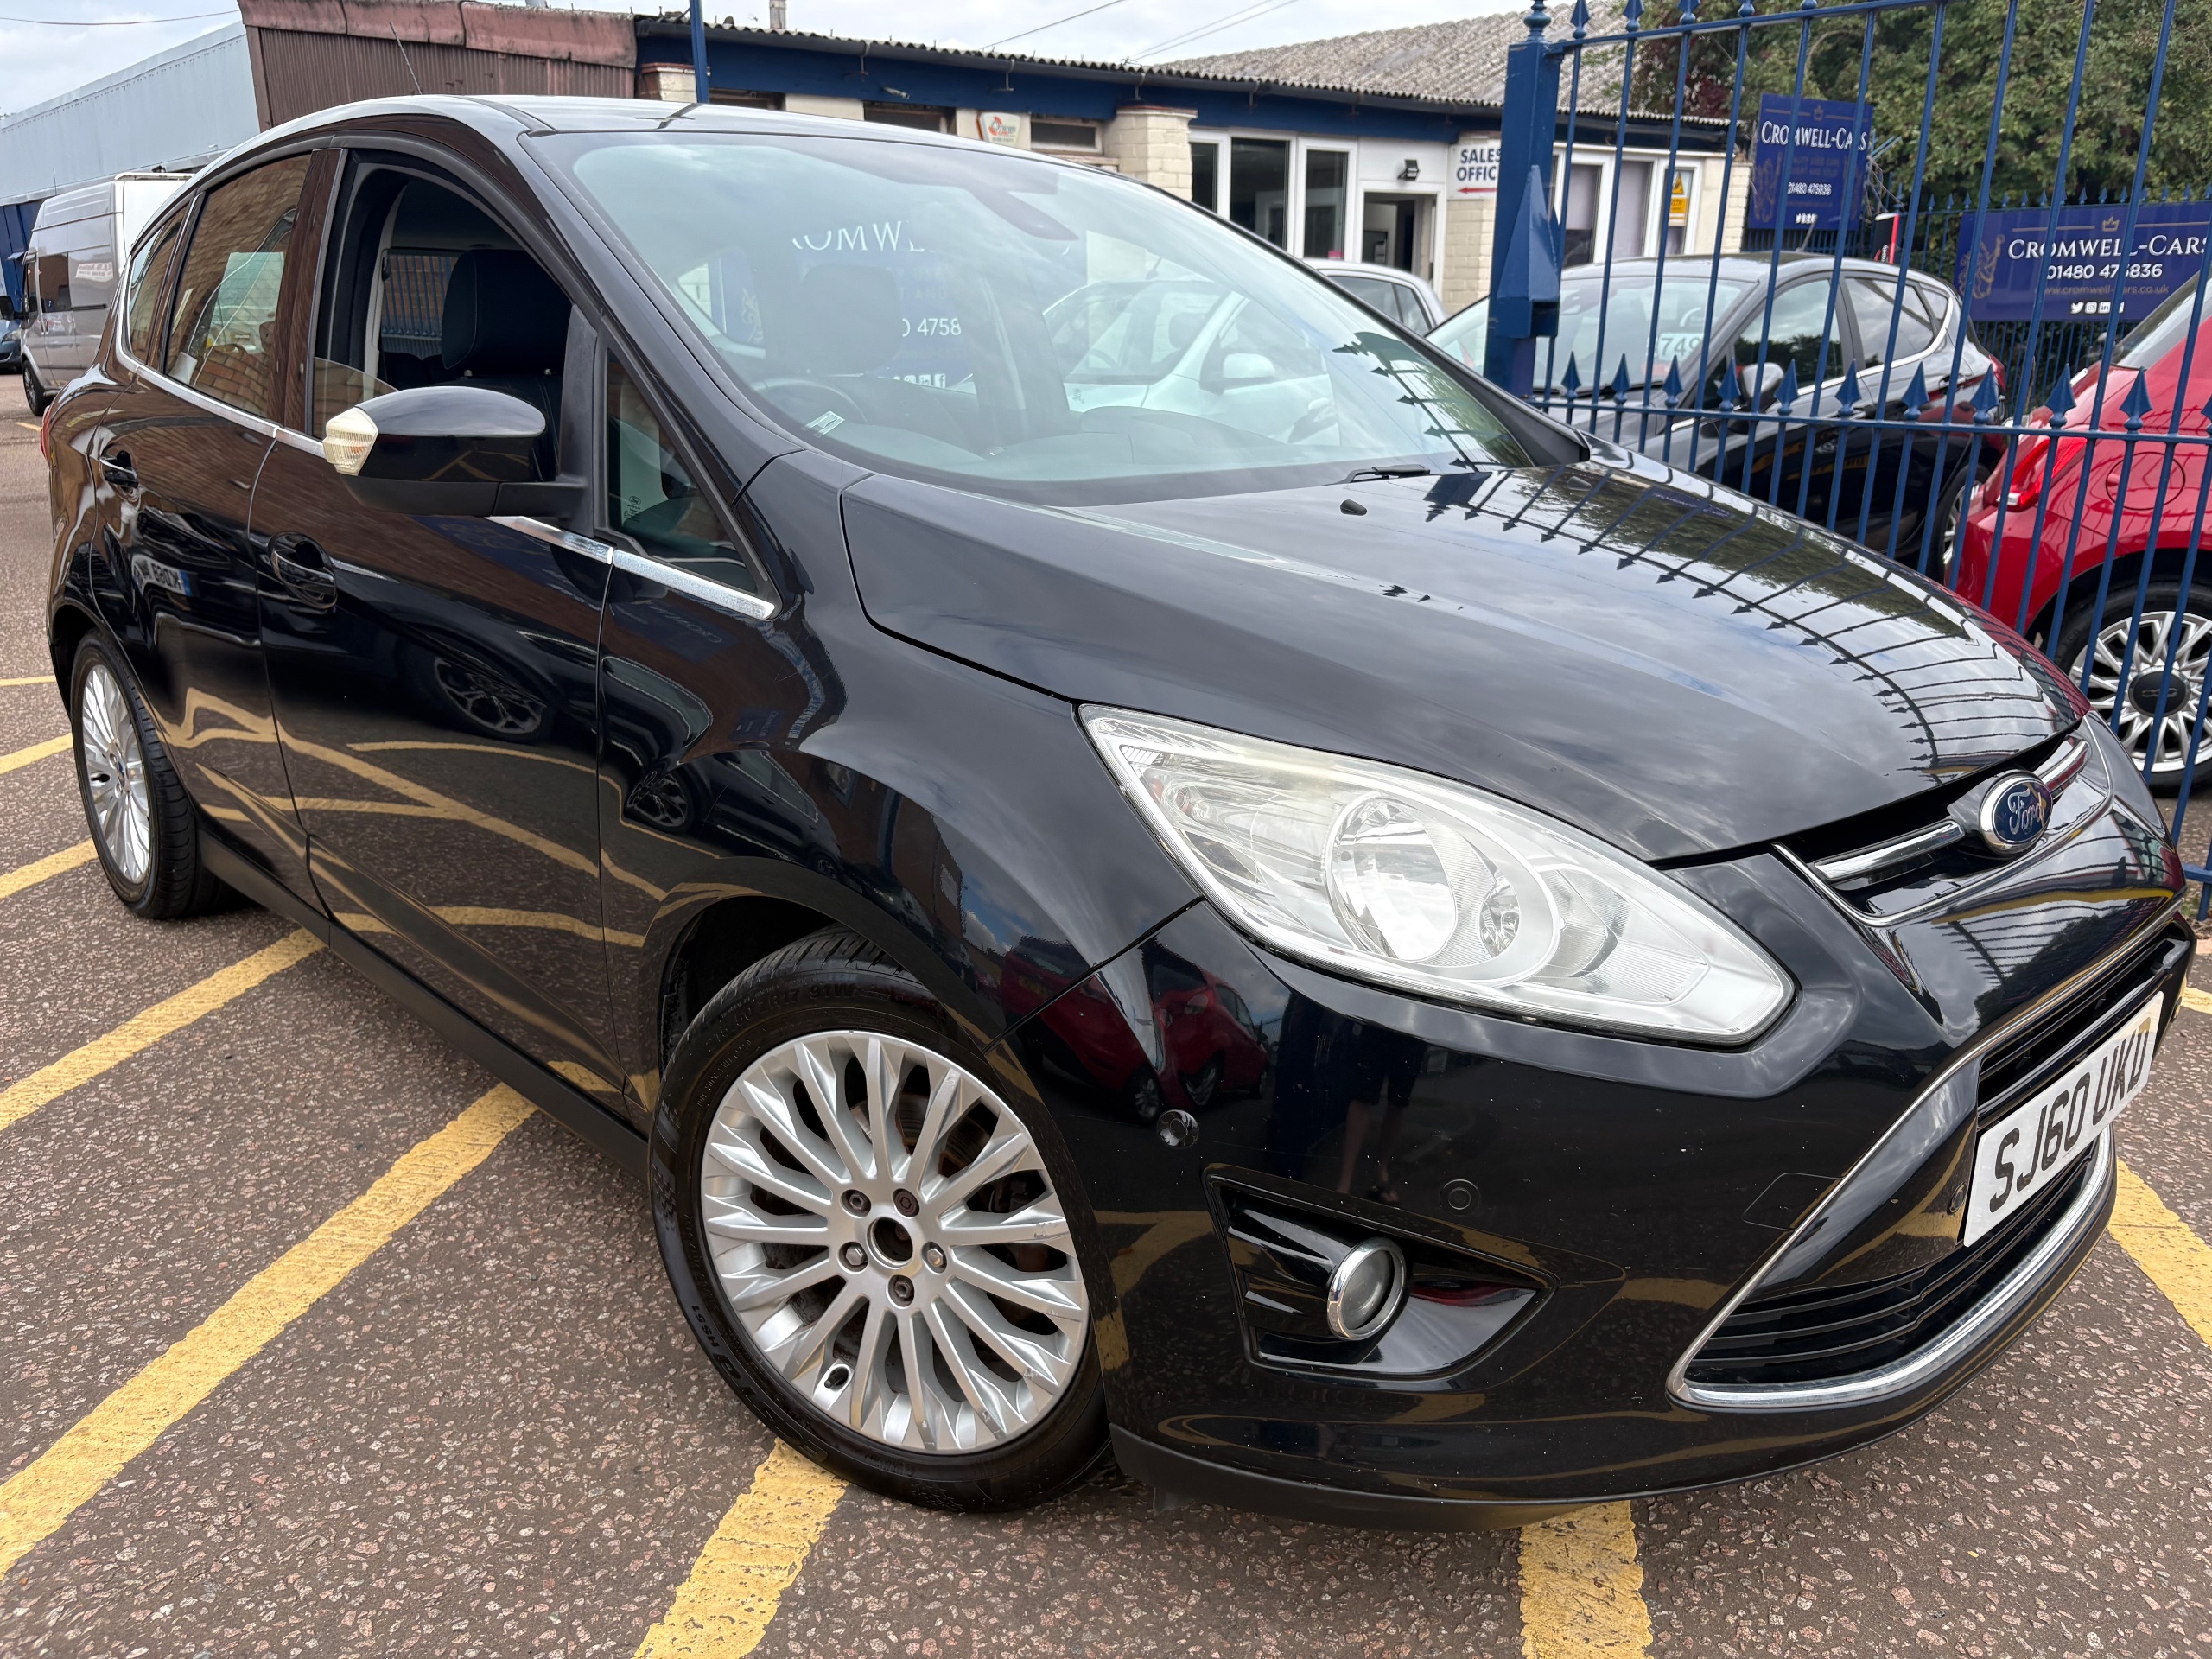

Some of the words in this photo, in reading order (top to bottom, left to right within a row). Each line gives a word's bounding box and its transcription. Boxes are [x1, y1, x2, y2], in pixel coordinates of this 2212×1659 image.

[1457, 166, 1497, 181] OFFIC
[2007, 787, 2045, 836] Ford
[1990, 1071, 2090, 1213] SJ60
